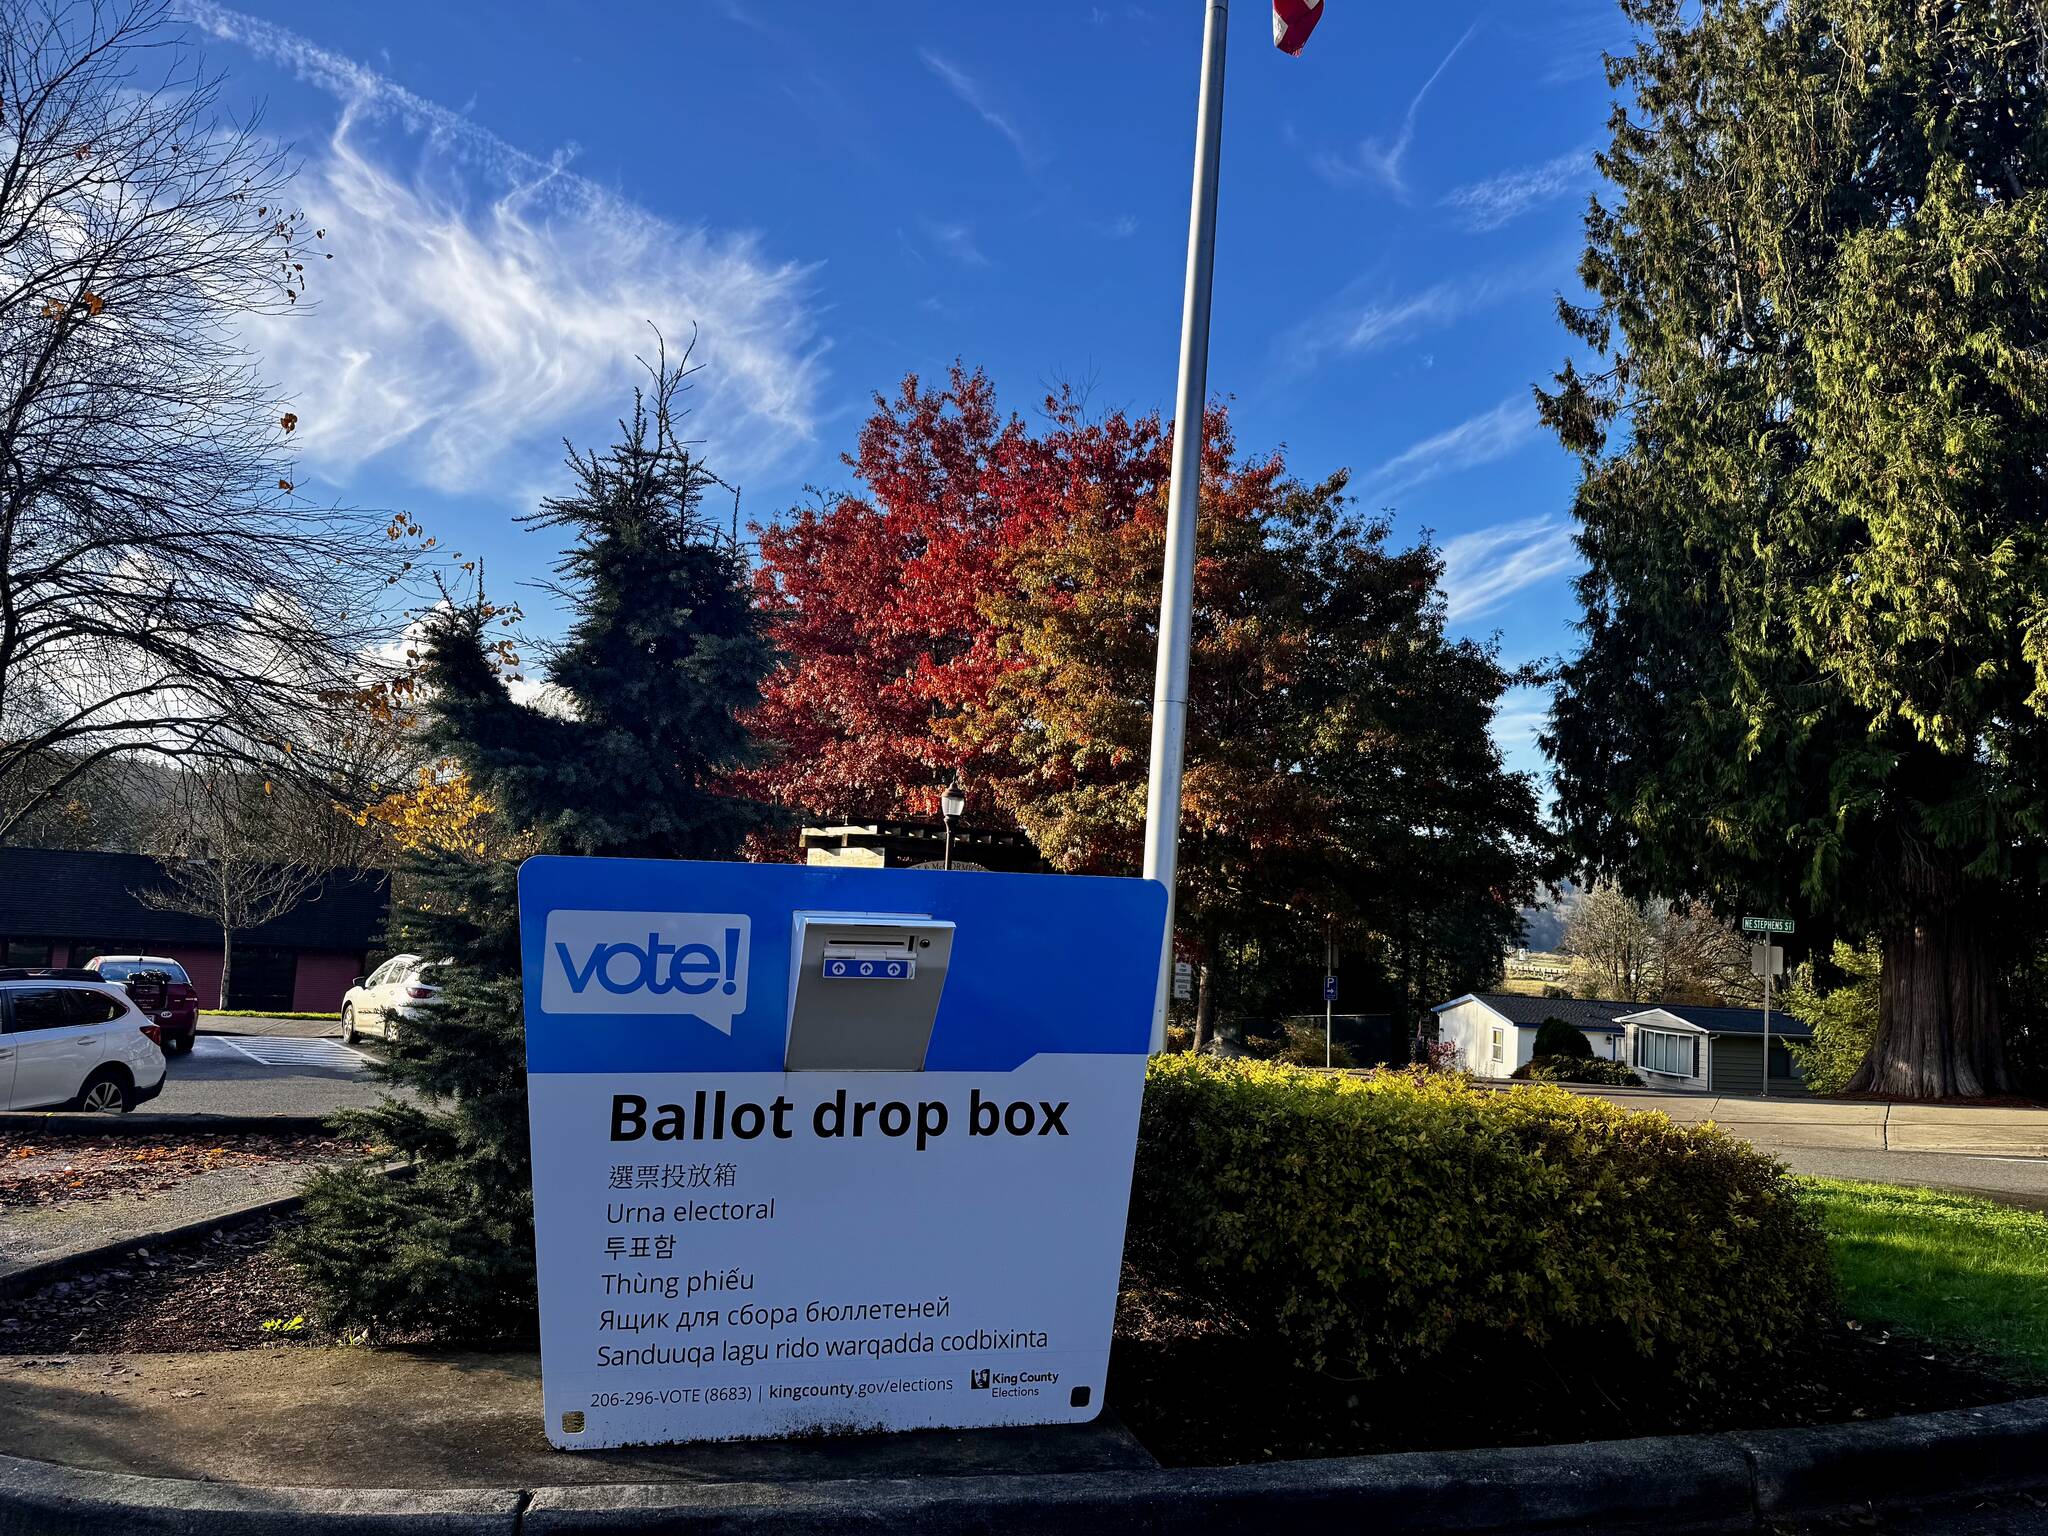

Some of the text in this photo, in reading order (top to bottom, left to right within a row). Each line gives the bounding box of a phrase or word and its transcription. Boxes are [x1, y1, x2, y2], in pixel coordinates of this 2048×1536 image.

[1745, 919, 1753, 928] NE
[1754, 920, 1783, 930] STEPHENS
[554, 928, 741, 995] vote!
[1327, 977, 1335, 988] P
[610, 1089, 1069, 1151] Ballot drop box
[609, 1163, 737, 1189] 選票投放箱
[608, 1198, 774, 1223] Urna electoral
[604, 1235, 676, 1260] 투표함
[602, 1268, 753, 1298] Thùng phiếu
[599, 1296, 949, 1334] Ящик для сбора бюллетеней
[597, 1329, 1047, 1368] Sanduuqa lagu rido warqadda codbixinta
[992, 1372, 1059, 1386] King County
[992, 1387, 1039, 1397] Elections
[591, 1389, 700, 1407] 206-296-VOTE
[705, 1387, 751, 1404] (8683)
[770, 1379, 952, 1401] kingcounty.gov/elections
